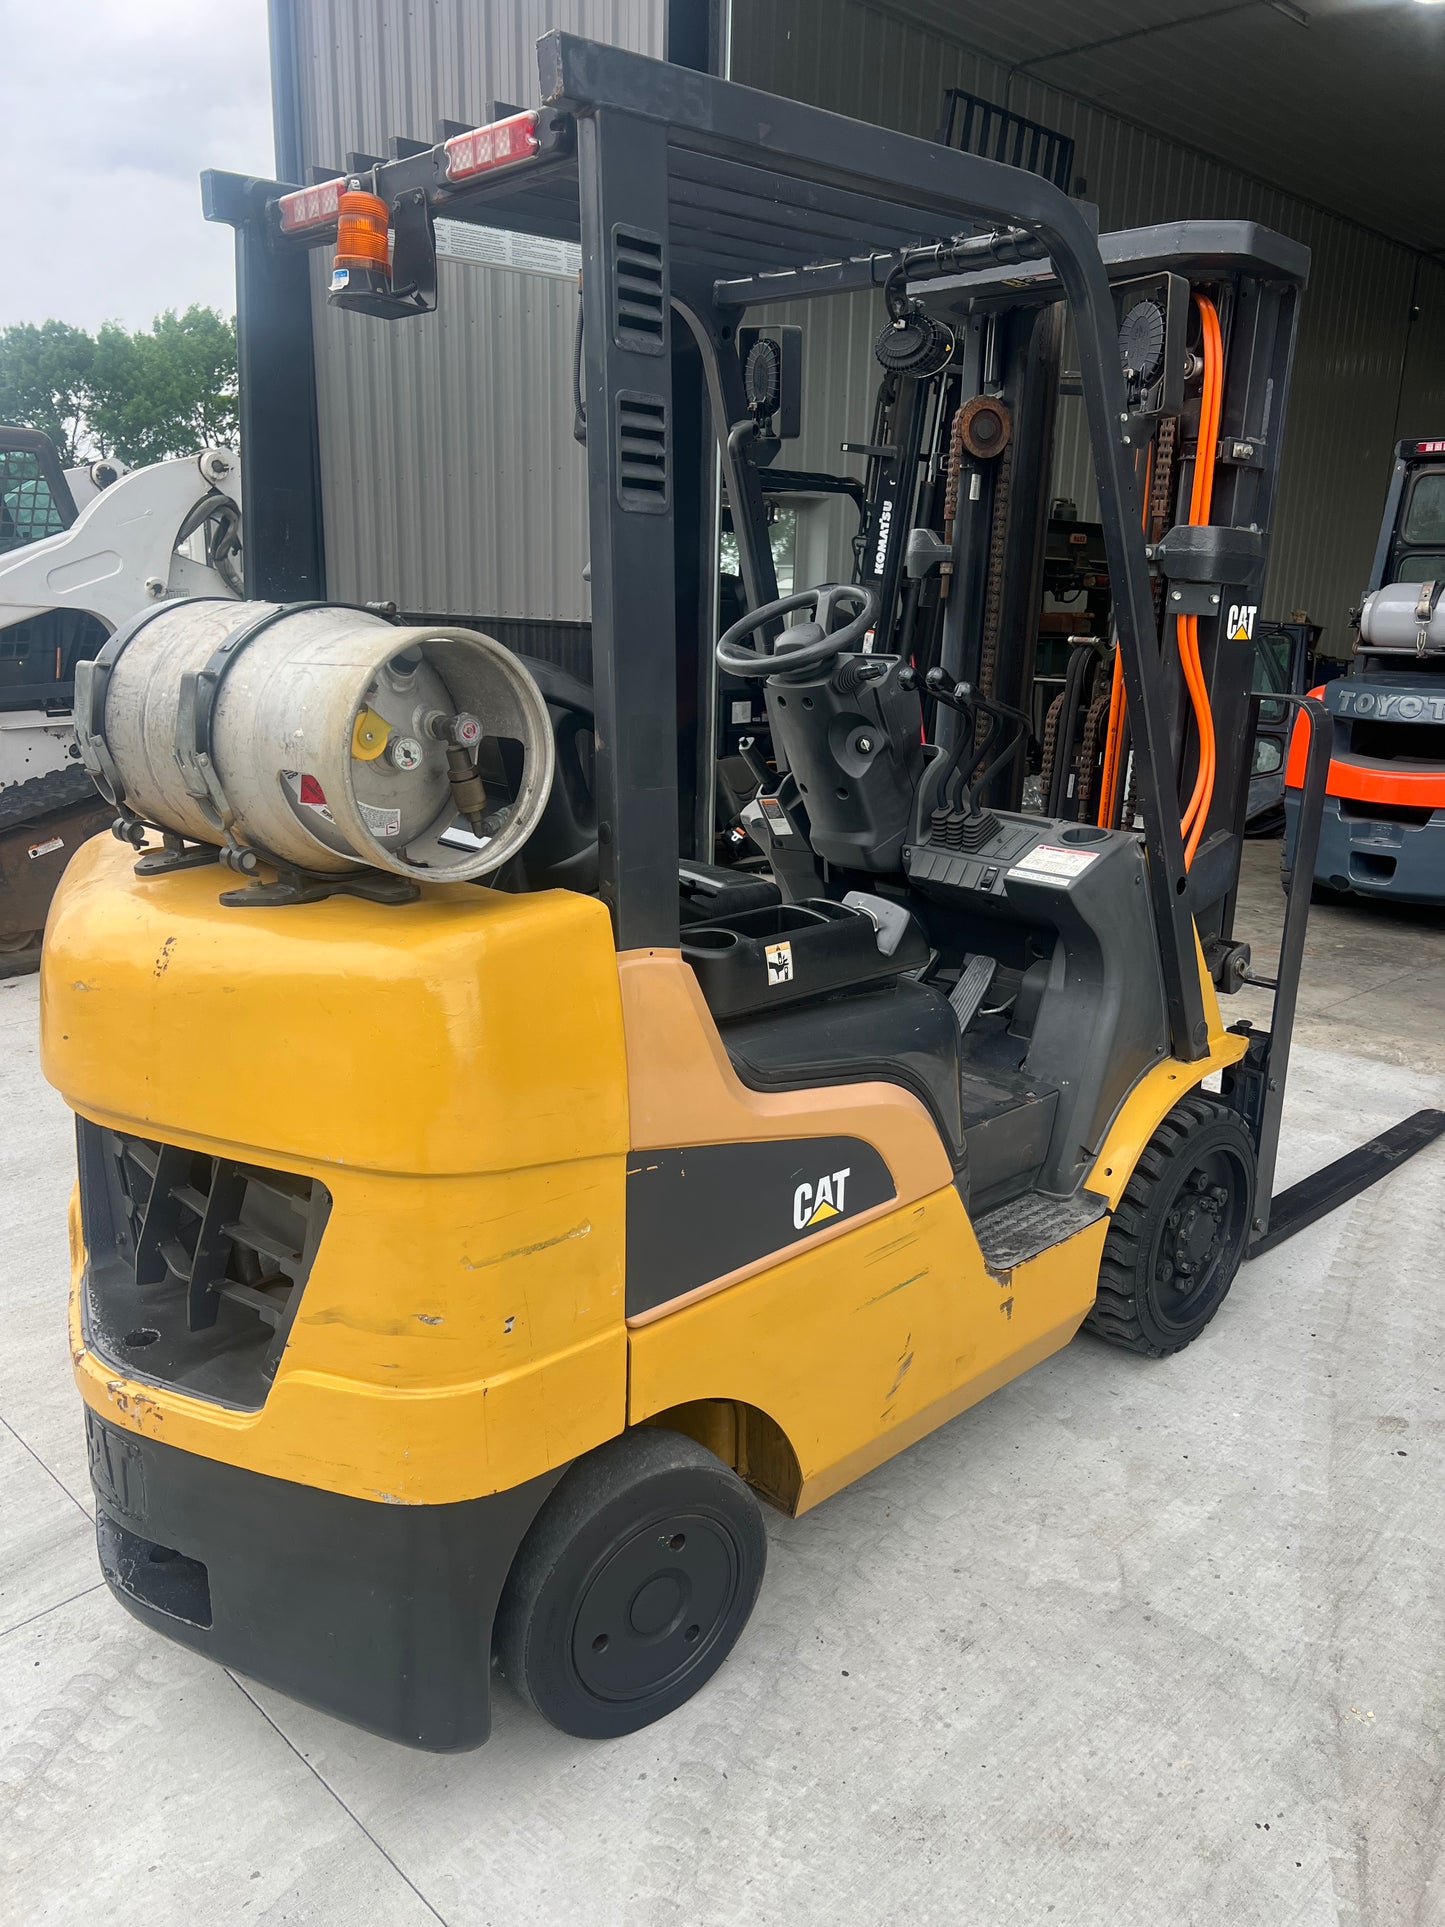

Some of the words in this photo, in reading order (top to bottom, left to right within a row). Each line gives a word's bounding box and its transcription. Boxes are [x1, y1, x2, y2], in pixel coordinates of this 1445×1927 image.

[874, 500, 893, 575] KOMATSU
[1226, 604, 1258, 640] CAT
[793, 1167, 850, 1230] CAT
